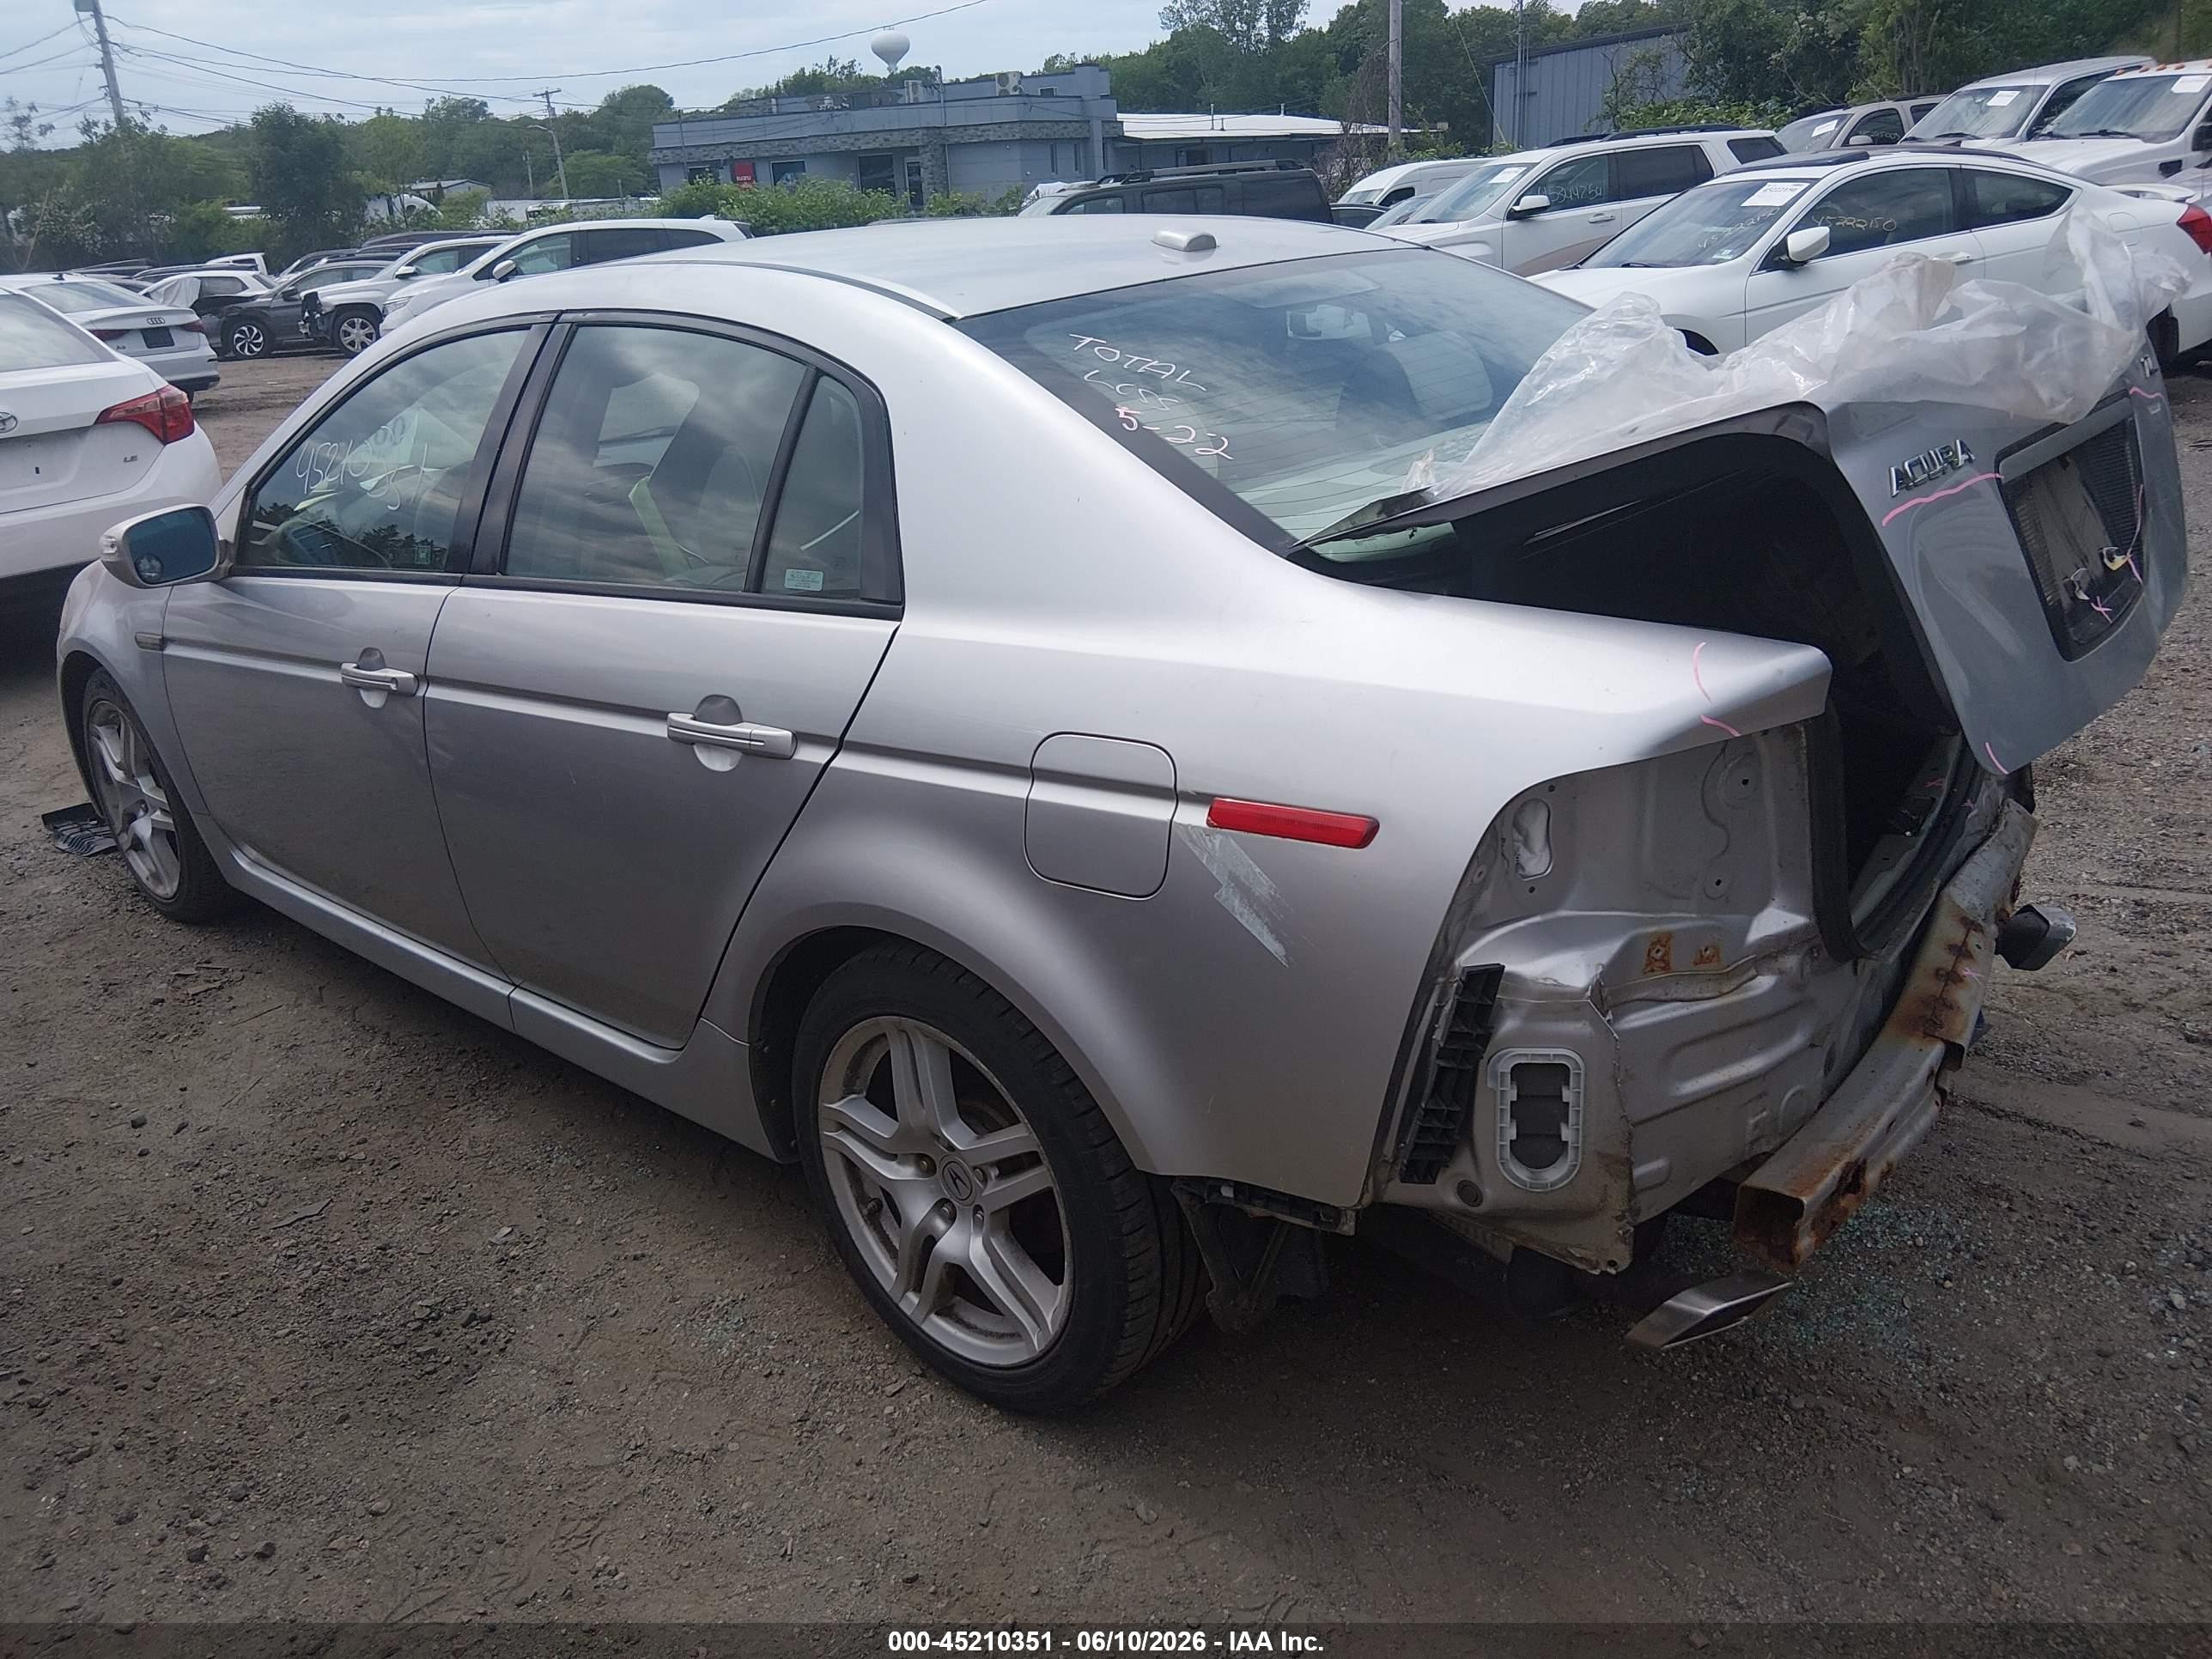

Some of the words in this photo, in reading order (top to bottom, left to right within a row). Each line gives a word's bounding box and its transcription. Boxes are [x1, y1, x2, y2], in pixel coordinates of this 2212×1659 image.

[1069, 333, 1207, 392] TOTAL
[1115, 404, 1235, 460] 5-22
[1889, 439, 1976, 497] ACURA
